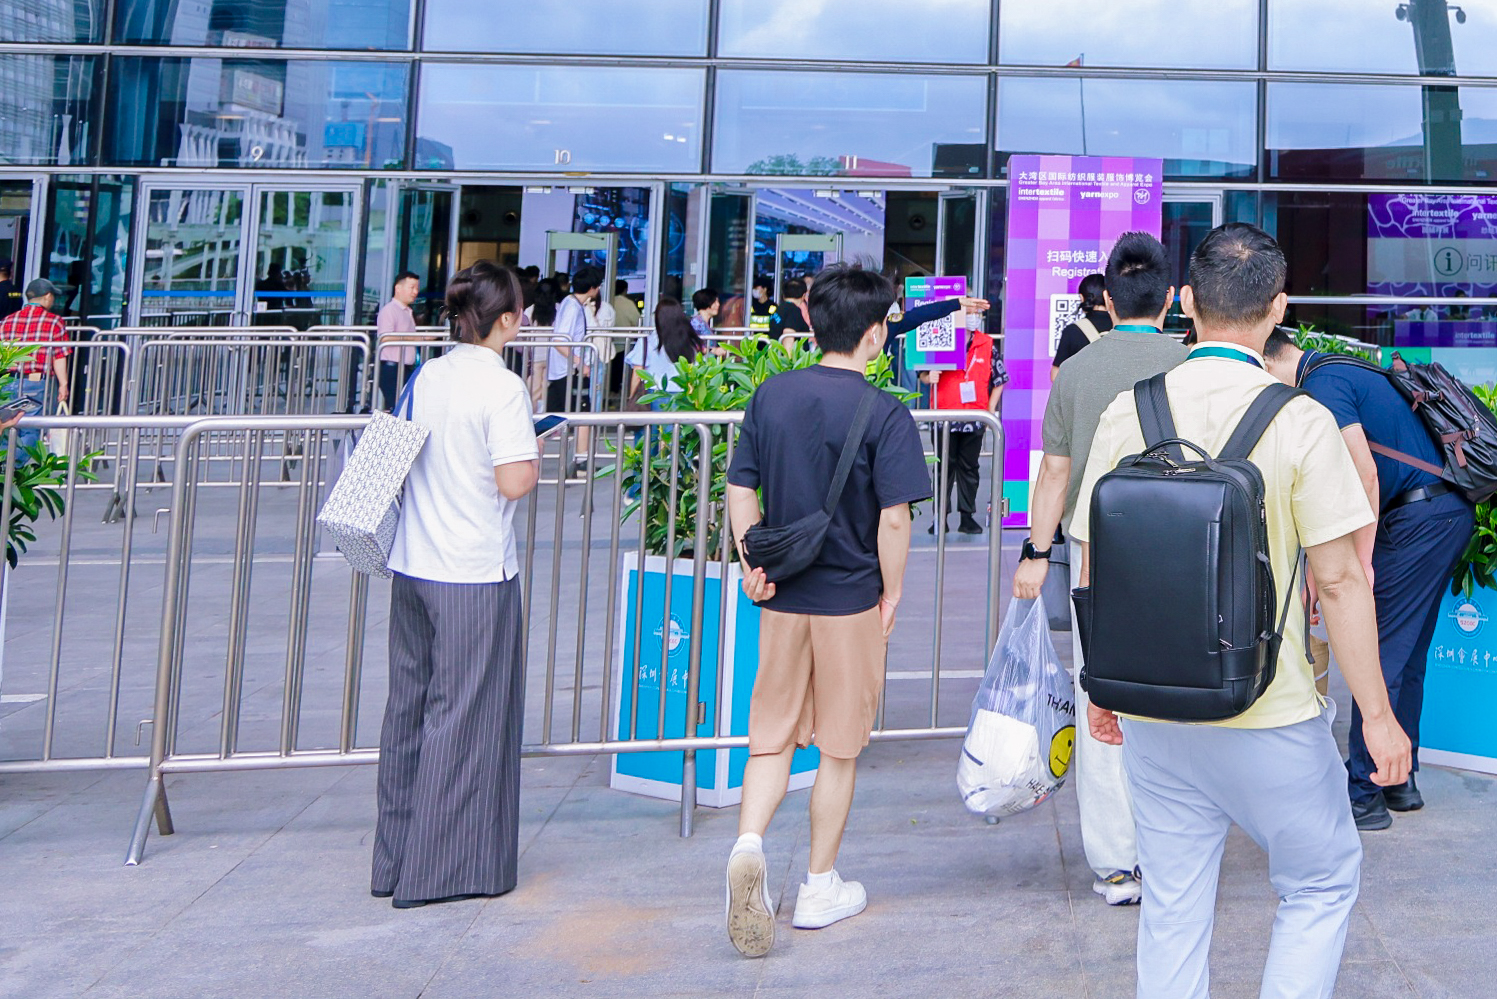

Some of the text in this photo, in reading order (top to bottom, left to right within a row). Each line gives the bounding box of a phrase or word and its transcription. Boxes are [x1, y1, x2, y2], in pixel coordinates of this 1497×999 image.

[250, 146, 263, 163] 9
[554, 149, 571, 165] 10
[844, 155, 858, 170] 11
[1018, 171, 1153, 183] 大湾区国际纺织服装服饰博览会
[1018, 188, 1065, 196] intertextile
[1080, 191, 1119, 199] yarnexpo
